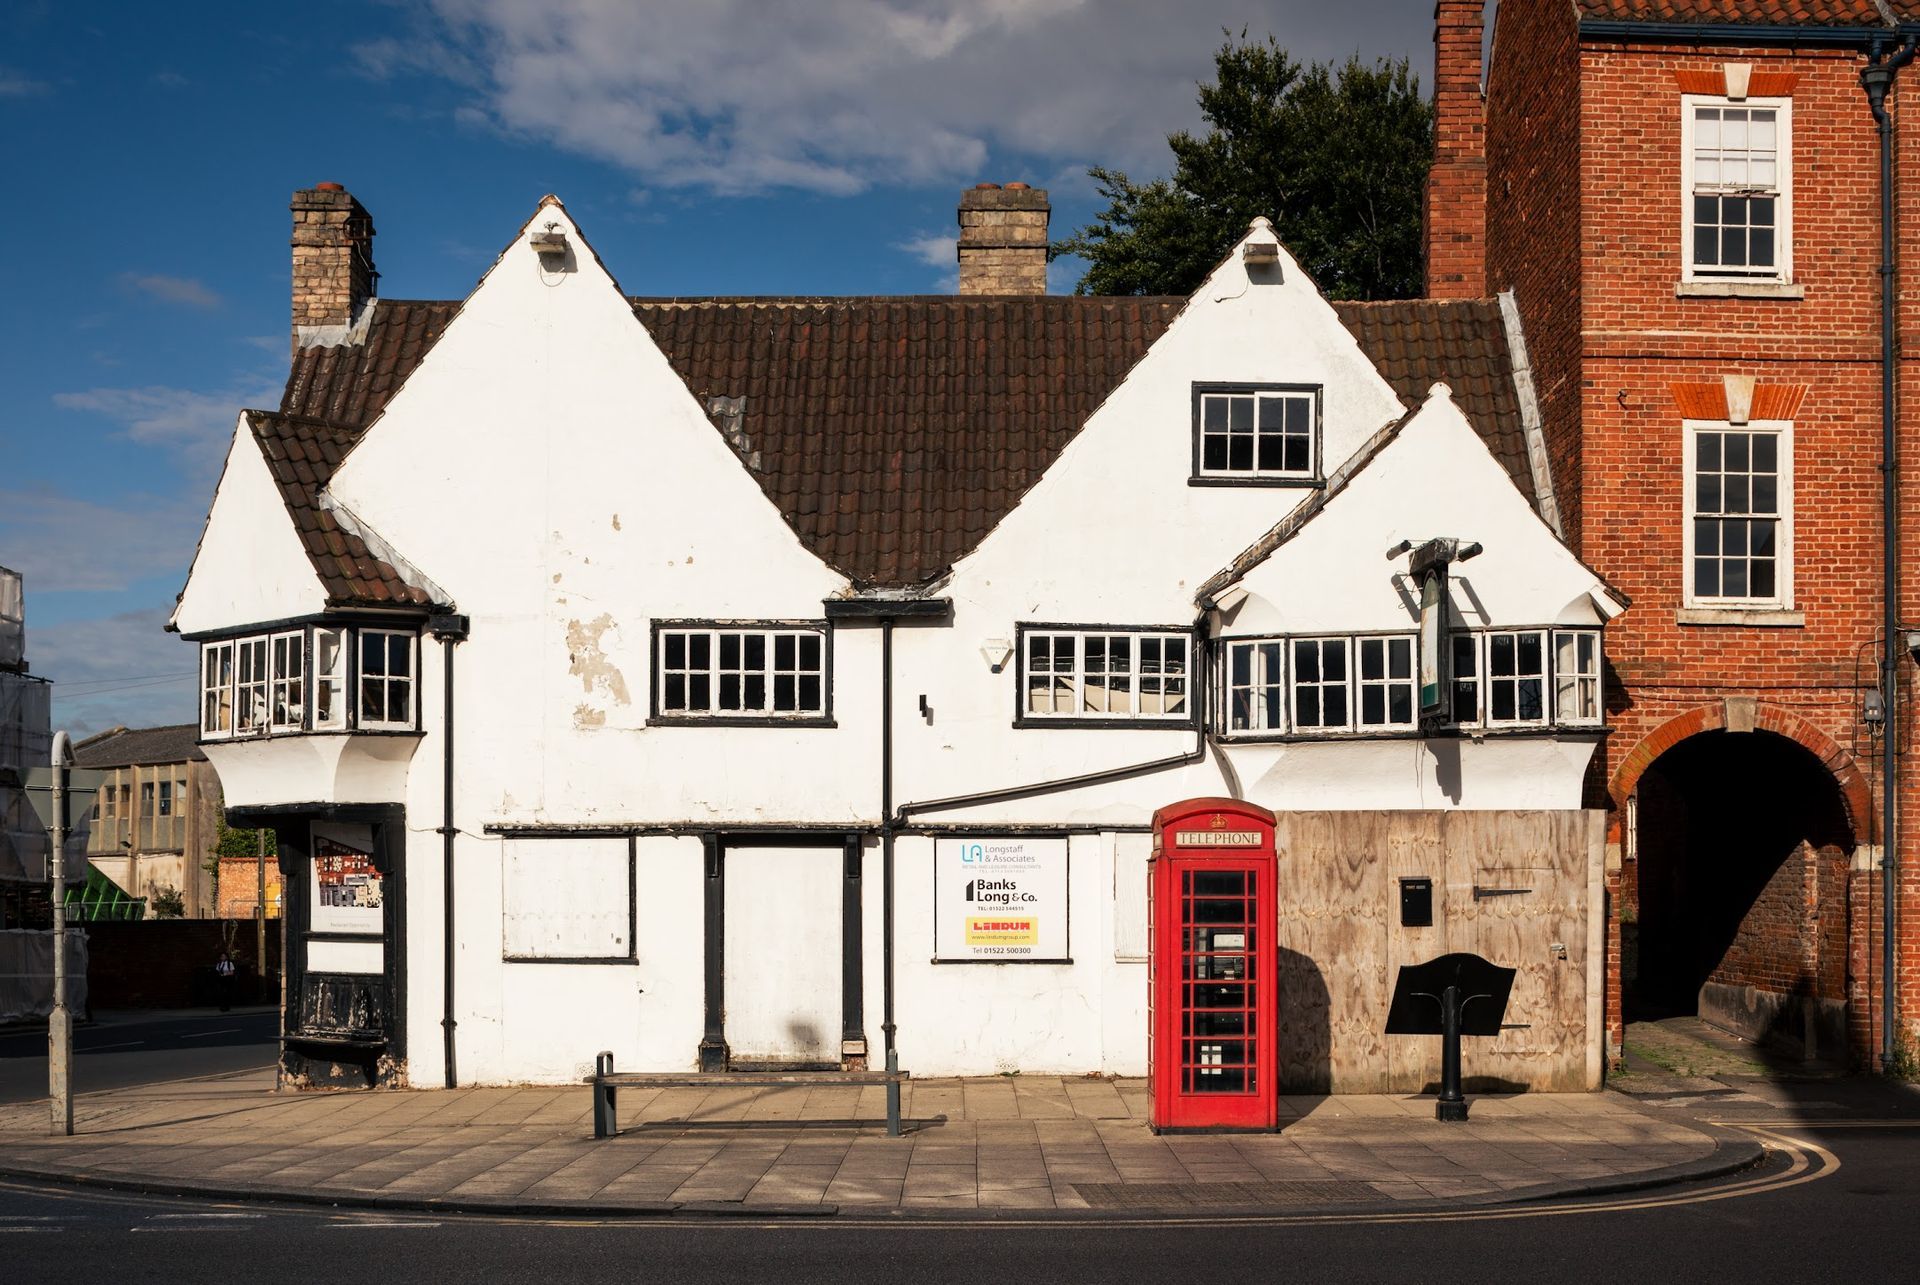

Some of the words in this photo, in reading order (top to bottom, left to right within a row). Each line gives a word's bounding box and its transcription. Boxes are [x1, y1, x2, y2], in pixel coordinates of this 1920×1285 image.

[1180, 833, 1260, 844] TELEPHONE
[985, 844, 1023, 855] Longstaff
[993, 854, 1035, 862] Associates
[977, 879, 1016, 890] Banks
[977, 891, 1009, 905] Long
[1012, 893, 1020, 902] &
[1021, 893, 1037, 902] Co.
